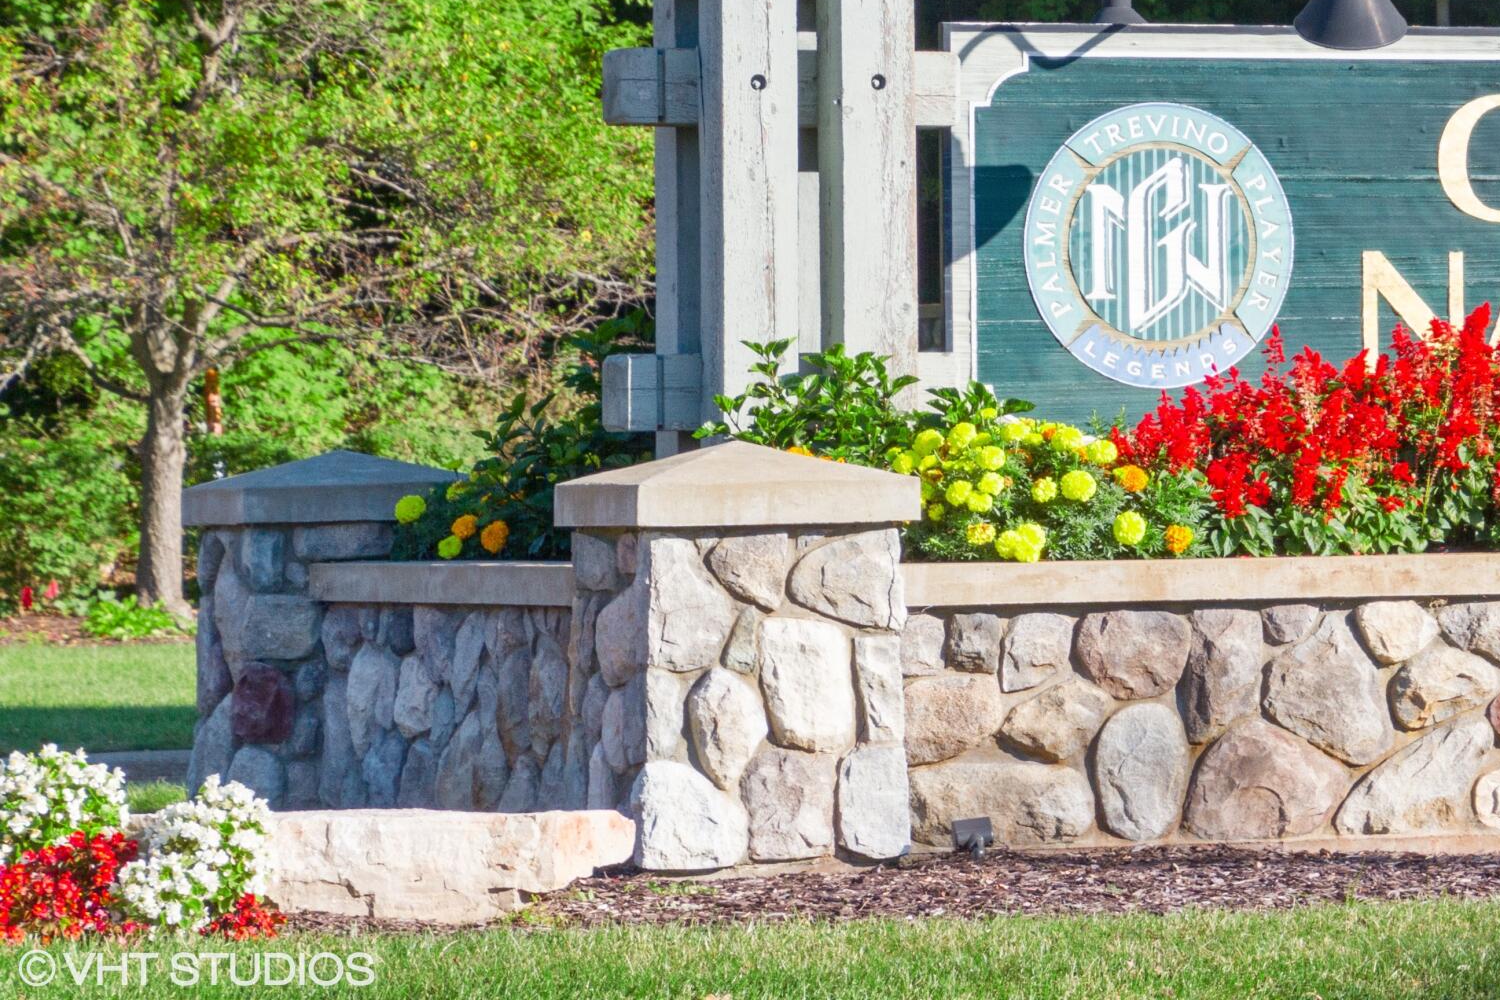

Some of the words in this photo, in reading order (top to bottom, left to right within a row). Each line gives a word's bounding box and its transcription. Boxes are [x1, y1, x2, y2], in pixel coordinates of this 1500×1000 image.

[1083, 114, 1229, 156] TREVINO
[1033, 172, 1075, 319] PALMER
[1244, 173, 1286, 312] PLAYER
[1083, 338, 1238, 379] LEGENDS
